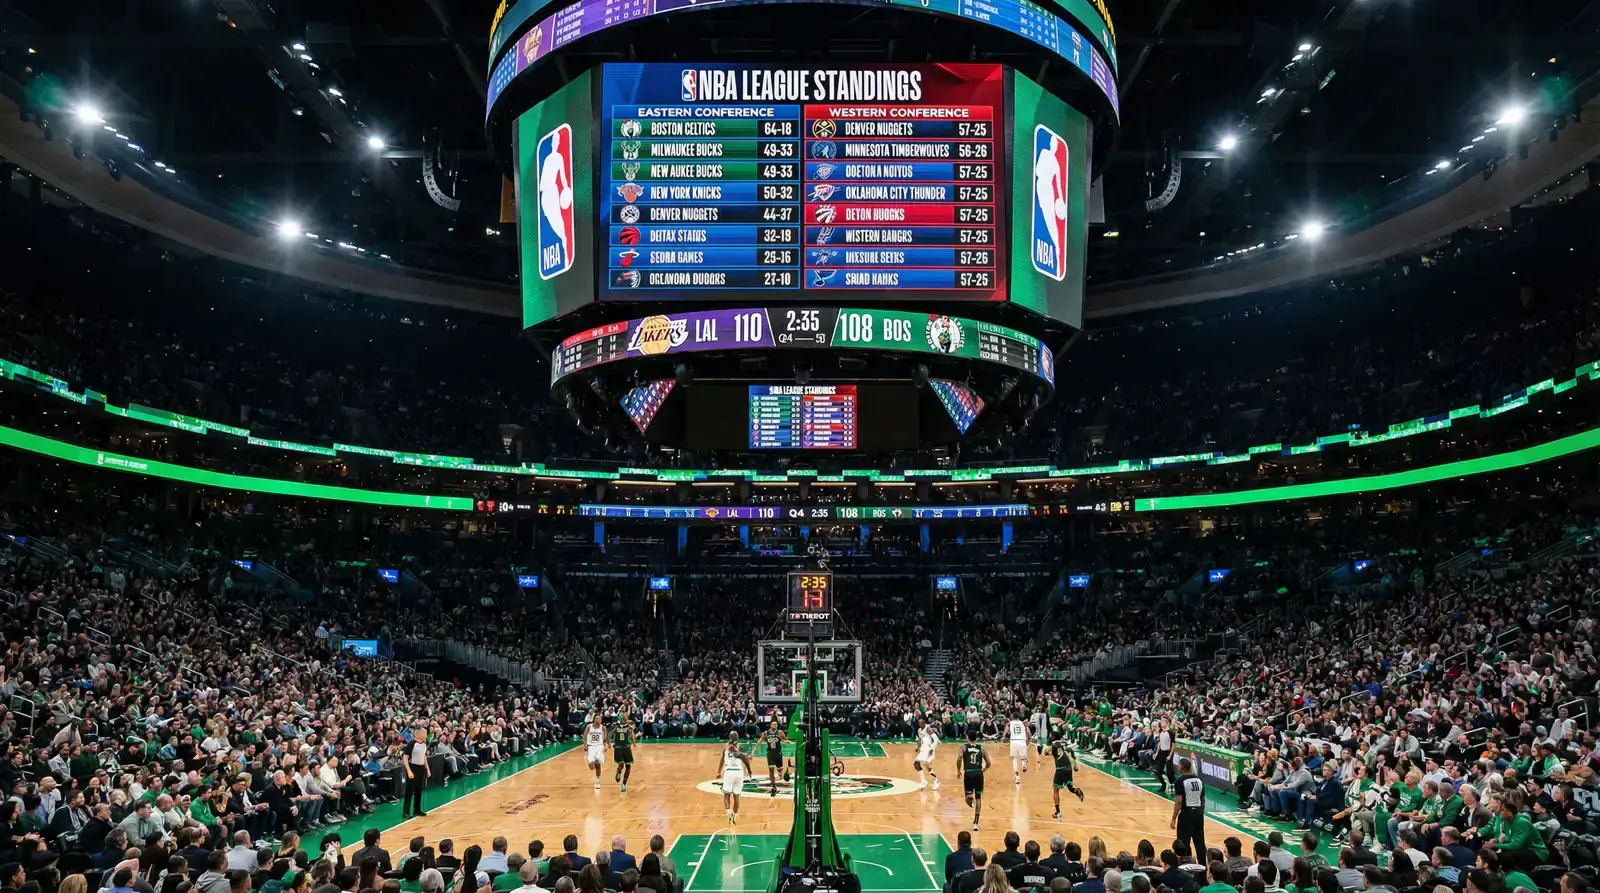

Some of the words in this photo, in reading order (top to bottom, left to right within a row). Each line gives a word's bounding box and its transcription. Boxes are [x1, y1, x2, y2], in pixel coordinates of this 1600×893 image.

[700, 70, 738, 100] NBA
[742, 70, 809, 101] LEAGUE
[813, 70, 922, 101] STANDINGS
[638, 108, 692, 117] EASTERN
[695, 108, 775, 117] CONFERENCE
[829, 108, 886, 118] WESTERN
[890, 108, 969, 118] CONFERENCE
[651, 122, 683, 136] BOSTON
[684, 122, 716, 136] CELTICS
[764, 122, 792, 136] 64-18
[845, 122, 876, 136] DENVER
[876, 122, 913, 136] NUGGETS
[958, 123, 987, 136] 57-25
[651, 143, 695, 157] MILWAUKEE
[696, 143, 723, 157] BUCKS
[763, 143, 793, 157] 49-33
[845, 143, 890, 157] MINNESOTA
[891, 143, 950, 157] TIMBERWOLVES
[959, 144, 988, 158] 56-26
[651, 164, 670, 178] NEW
[671, 164, 695, 178] AUKEE
[696, 164, 723, 178] BUCKS
[763, 165, 793, 178] 49-33
[959, 165, 988, 179] 57-25
[650, 186, 669, 200] NEW
[669, 186, 692, 200] YORK
[692, 186, 722, 200] KNICKS
[763, 186, 793, 200] 50-32
[845, 186, 889, 200] OKLAHOMA
[889, 186, 908, 200] CITY
[909, 186, 946, 200] THUNDER
[959, 187, 988, 201] 57-25
[650, 207, 681, 221] DENVER
[682, 207, 718, 221] NUGGETS
[763, 207, 792, 221] 44-37
[959, 208, 988, 222] 57-25
[763, 229, 792, 243] 32-18
[960, 229, 988, 243] 57-25
[543, 242, 561, 271] NBA
[763, 251, 792, 264] 25-16
[1036, 238, 1054, 269] NBA
[764, 272, 792, 286] 27-10
[960, 273, 989, 286] 57-25
[786, 309, 820, 331] 2:35
[840, 312, 873, 342] 108
[883, 318, 912, 342] BOS
[695, 318, 718, 342] LAL
[734, 313, 762, 342] 110
[727, 509, 739, 518] LAL
[758, 508, 774, 518] 110
[789, 509, 804, 518] Q4
[841, 508, 858, 518] 108
[873, 509, 886, 518] BOS
[801, 576, 827, 588] 2:35
